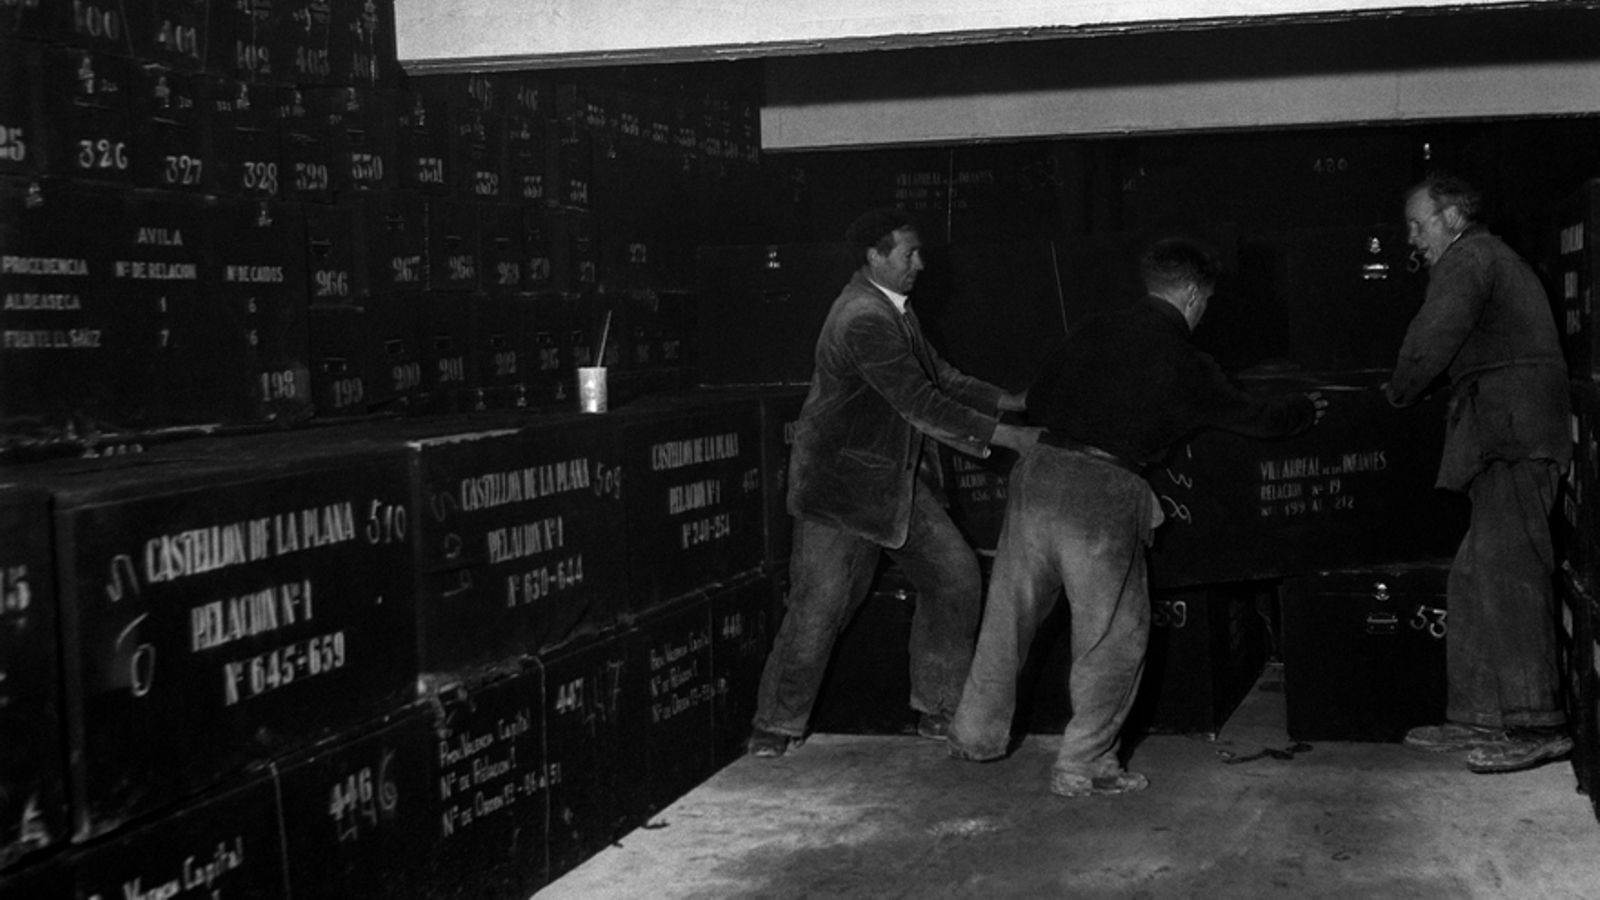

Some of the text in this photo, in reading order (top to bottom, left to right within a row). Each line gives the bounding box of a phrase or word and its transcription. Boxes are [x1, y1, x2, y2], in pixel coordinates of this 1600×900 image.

[77, 138, 129, 170] 326
[164, 154, 203, 185] 327
[351, 153, 383, 180] 330
[1312, 157, 1348, 174] 480
[242, 161, 278, 194] 328
[295, 161, 328, 191] 329
[137, 227, 184, 246] AVILA
[159, 297, 168, 312] 1
[260, 369, 297, 402] 198
[332, 377, 364, 407] 199
[461, 471, 523, 512] CASTELLON
[145, 521, 246, 583] CASTELLON
[249, 517, 270, 563] DE
[274, 511, 300, 556] LA
[302, 501, 355, 549] PLANA
[190, 587, 279, 652] RELACION
[250, 630, 345, 696] 645-659
[327, 766, 373, 822] 446
